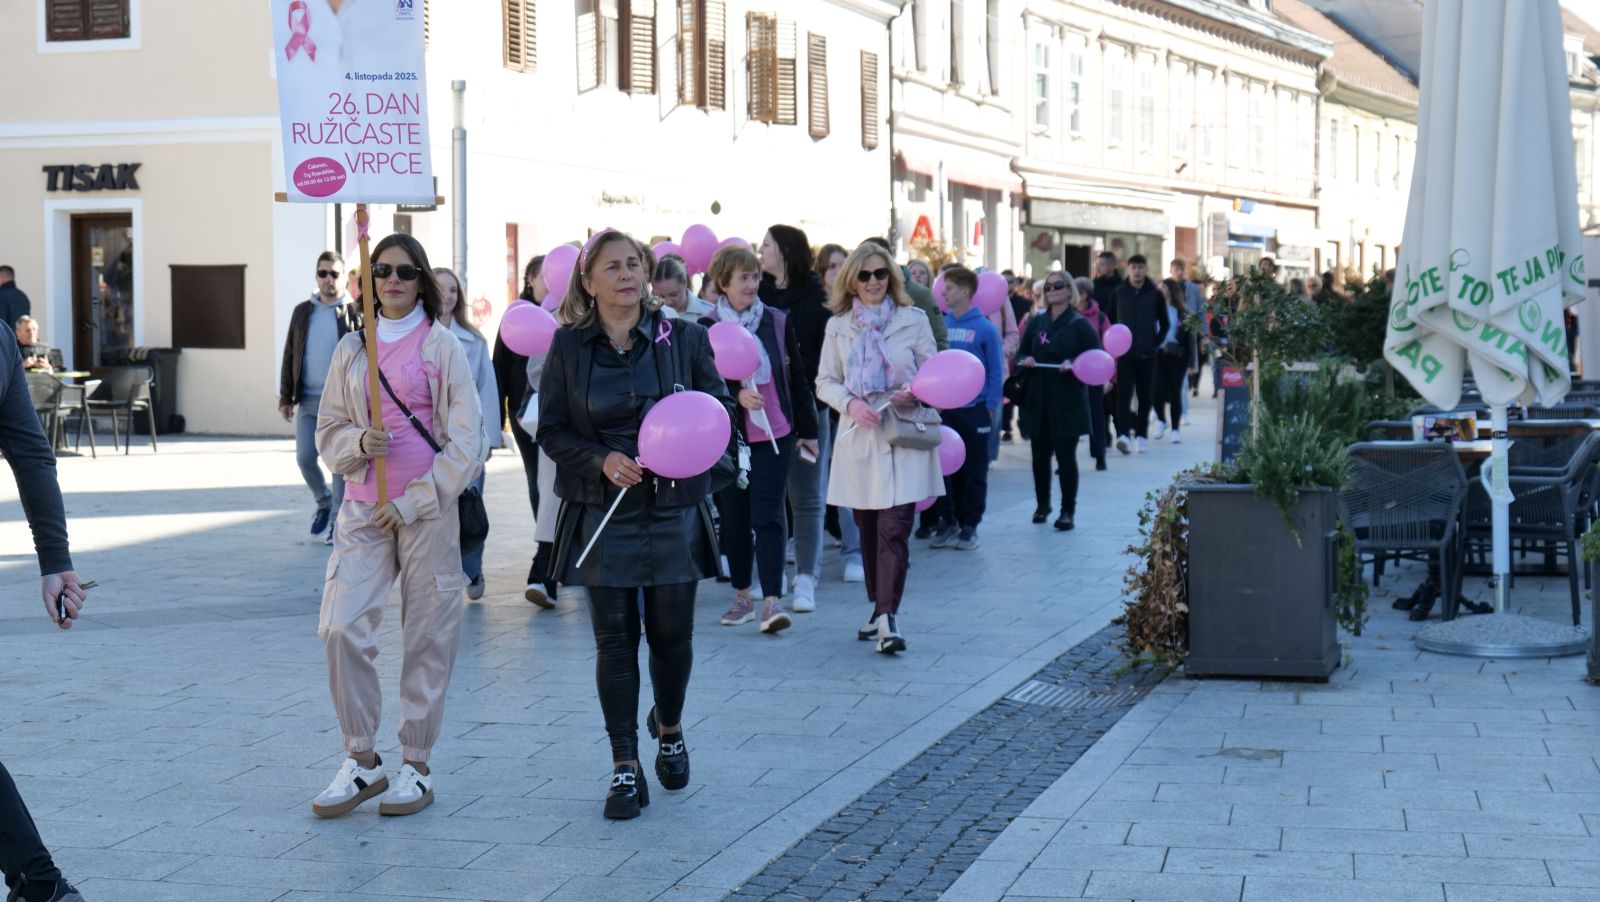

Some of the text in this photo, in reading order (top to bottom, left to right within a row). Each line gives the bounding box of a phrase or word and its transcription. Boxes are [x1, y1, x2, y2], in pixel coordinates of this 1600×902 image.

[345, 72, 418, 82] 4. listopada 2025.
[328, 92, 420, 115] 26. DAN
[292, 117, 422, 145] RUŽIČASTE
[344, 152, 423, 174] VRPCE
[42, 163, 141, 192] TISAK
[1496, 265, 1520, 296] TE
[1522, 255, 1545, 285] JA
[1545, 243, 1562, 275] PI
